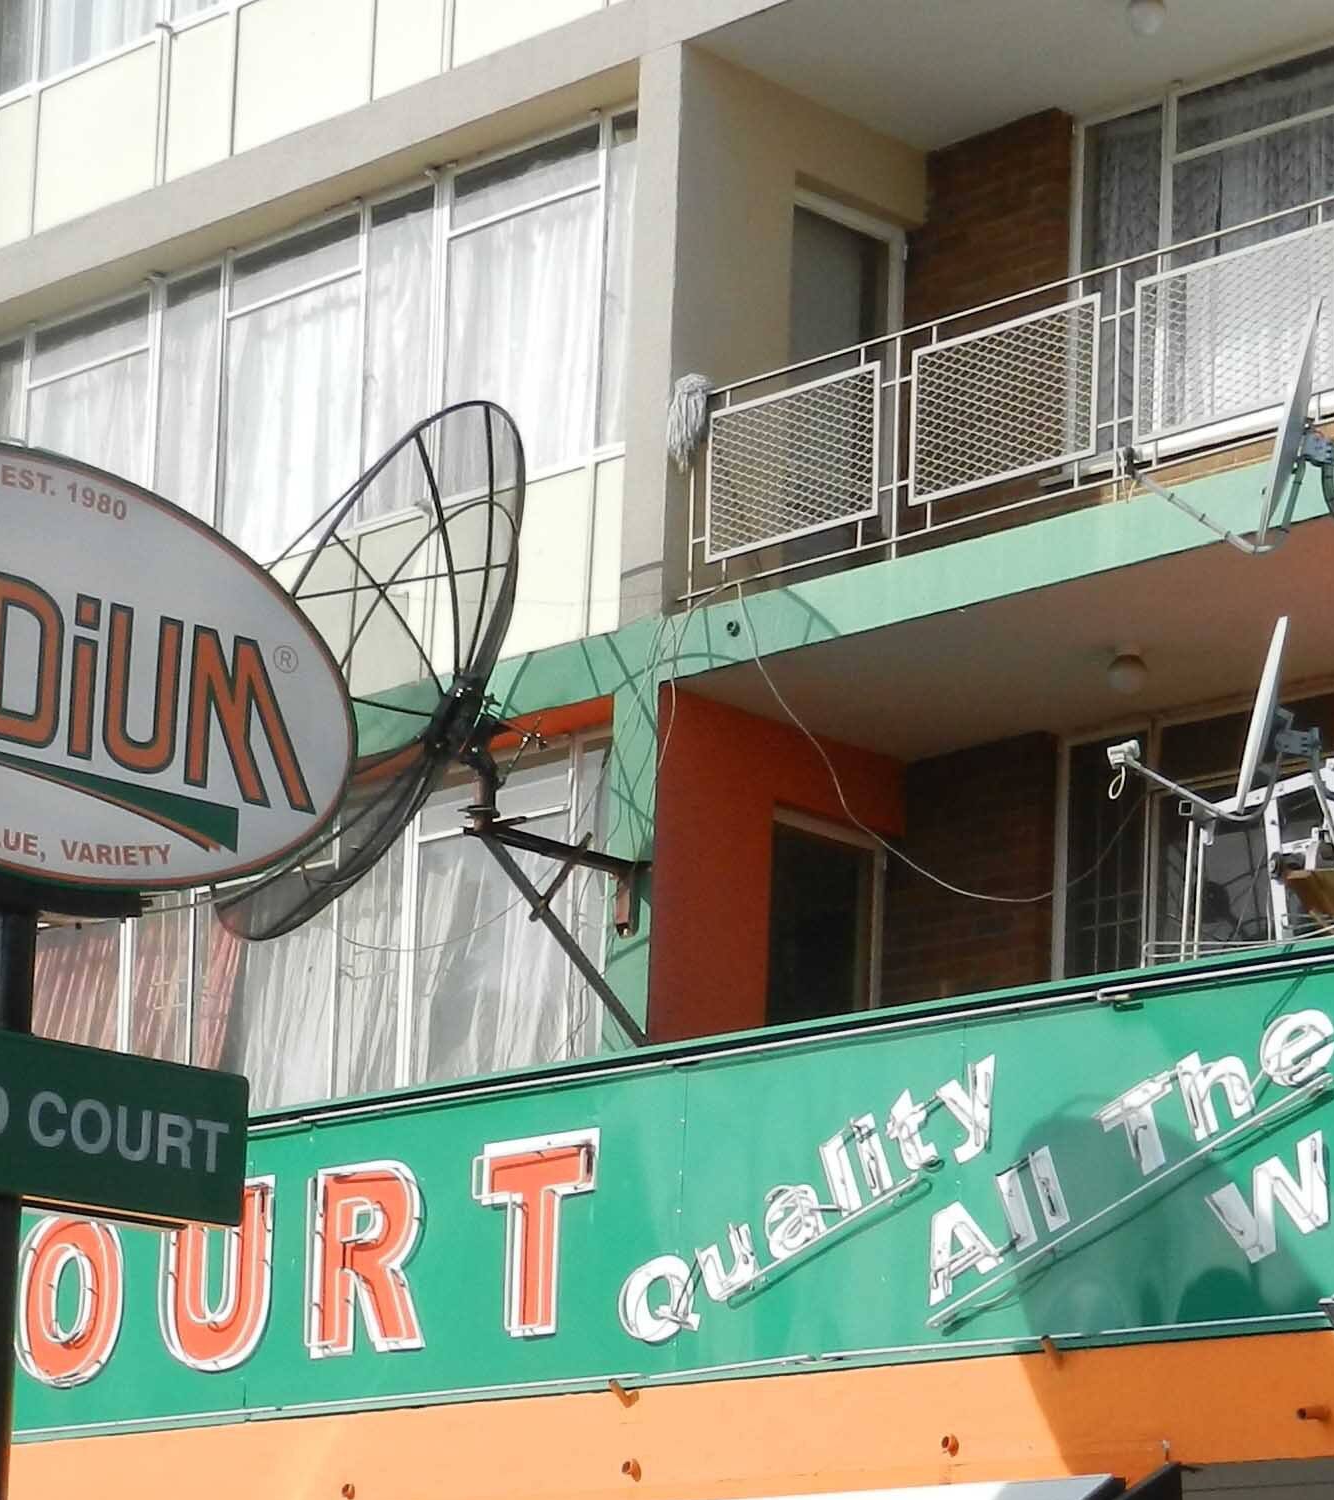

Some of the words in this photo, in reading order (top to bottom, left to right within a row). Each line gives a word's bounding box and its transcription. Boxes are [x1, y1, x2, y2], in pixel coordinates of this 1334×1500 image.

[0, 464, 57, 496] EST.
[67, 480, 128, 521] 1980
[61, 838, 172, 867] VARIETY
[28, 1091, 230, 1173] COURT
[615, 1053, 997, 1344] Quality
[928, 1145, 1069, 1308] All
